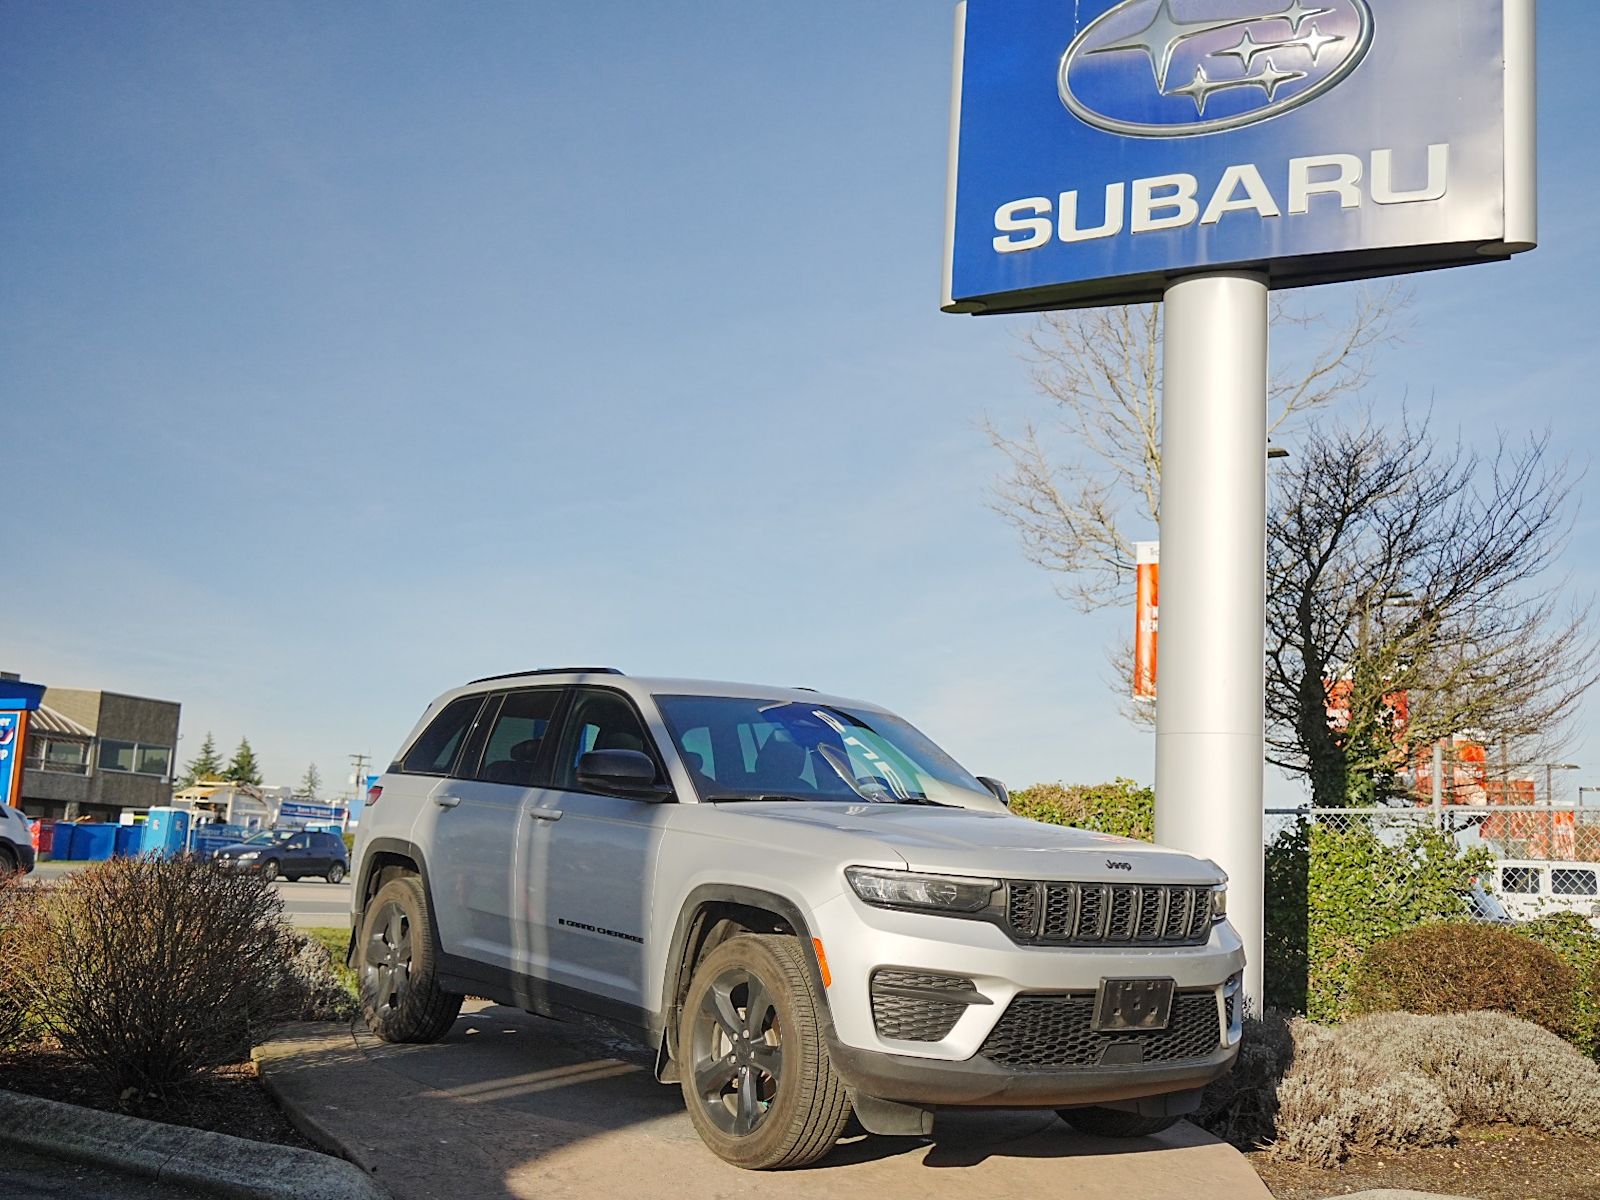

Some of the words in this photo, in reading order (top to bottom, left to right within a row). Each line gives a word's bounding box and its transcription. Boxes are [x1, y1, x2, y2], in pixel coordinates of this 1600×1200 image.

[992, 143, 1450, 254] SUBARU
[1105, 859, 1132, 871] Jeep
[566, 919, 596, 932] GRAND
[597, 926, 644, 945] CHEROKEE
